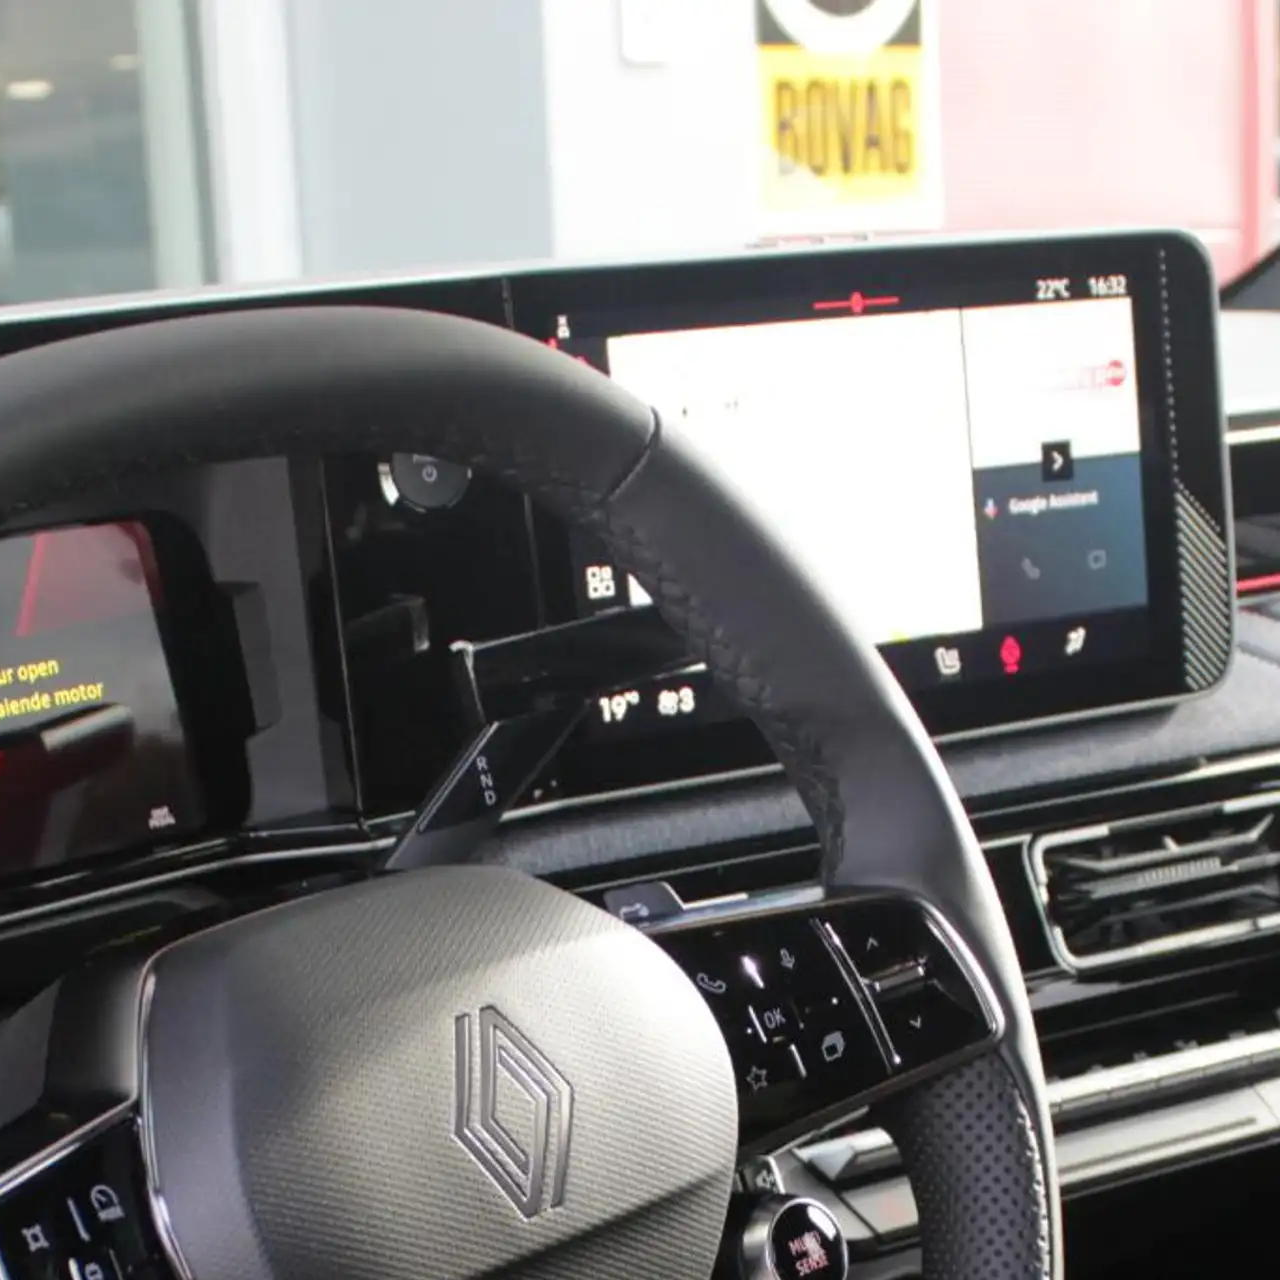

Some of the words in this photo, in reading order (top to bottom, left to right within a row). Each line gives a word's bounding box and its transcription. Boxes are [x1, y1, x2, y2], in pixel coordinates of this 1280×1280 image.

[774, 78, 914, 176] BOVAG
[1009, 496, 1047, 515] Google
[18, 659, 60, 684] open
[54, 682, 105, 705] motor
[763, 1007, 787, 1029] OK
